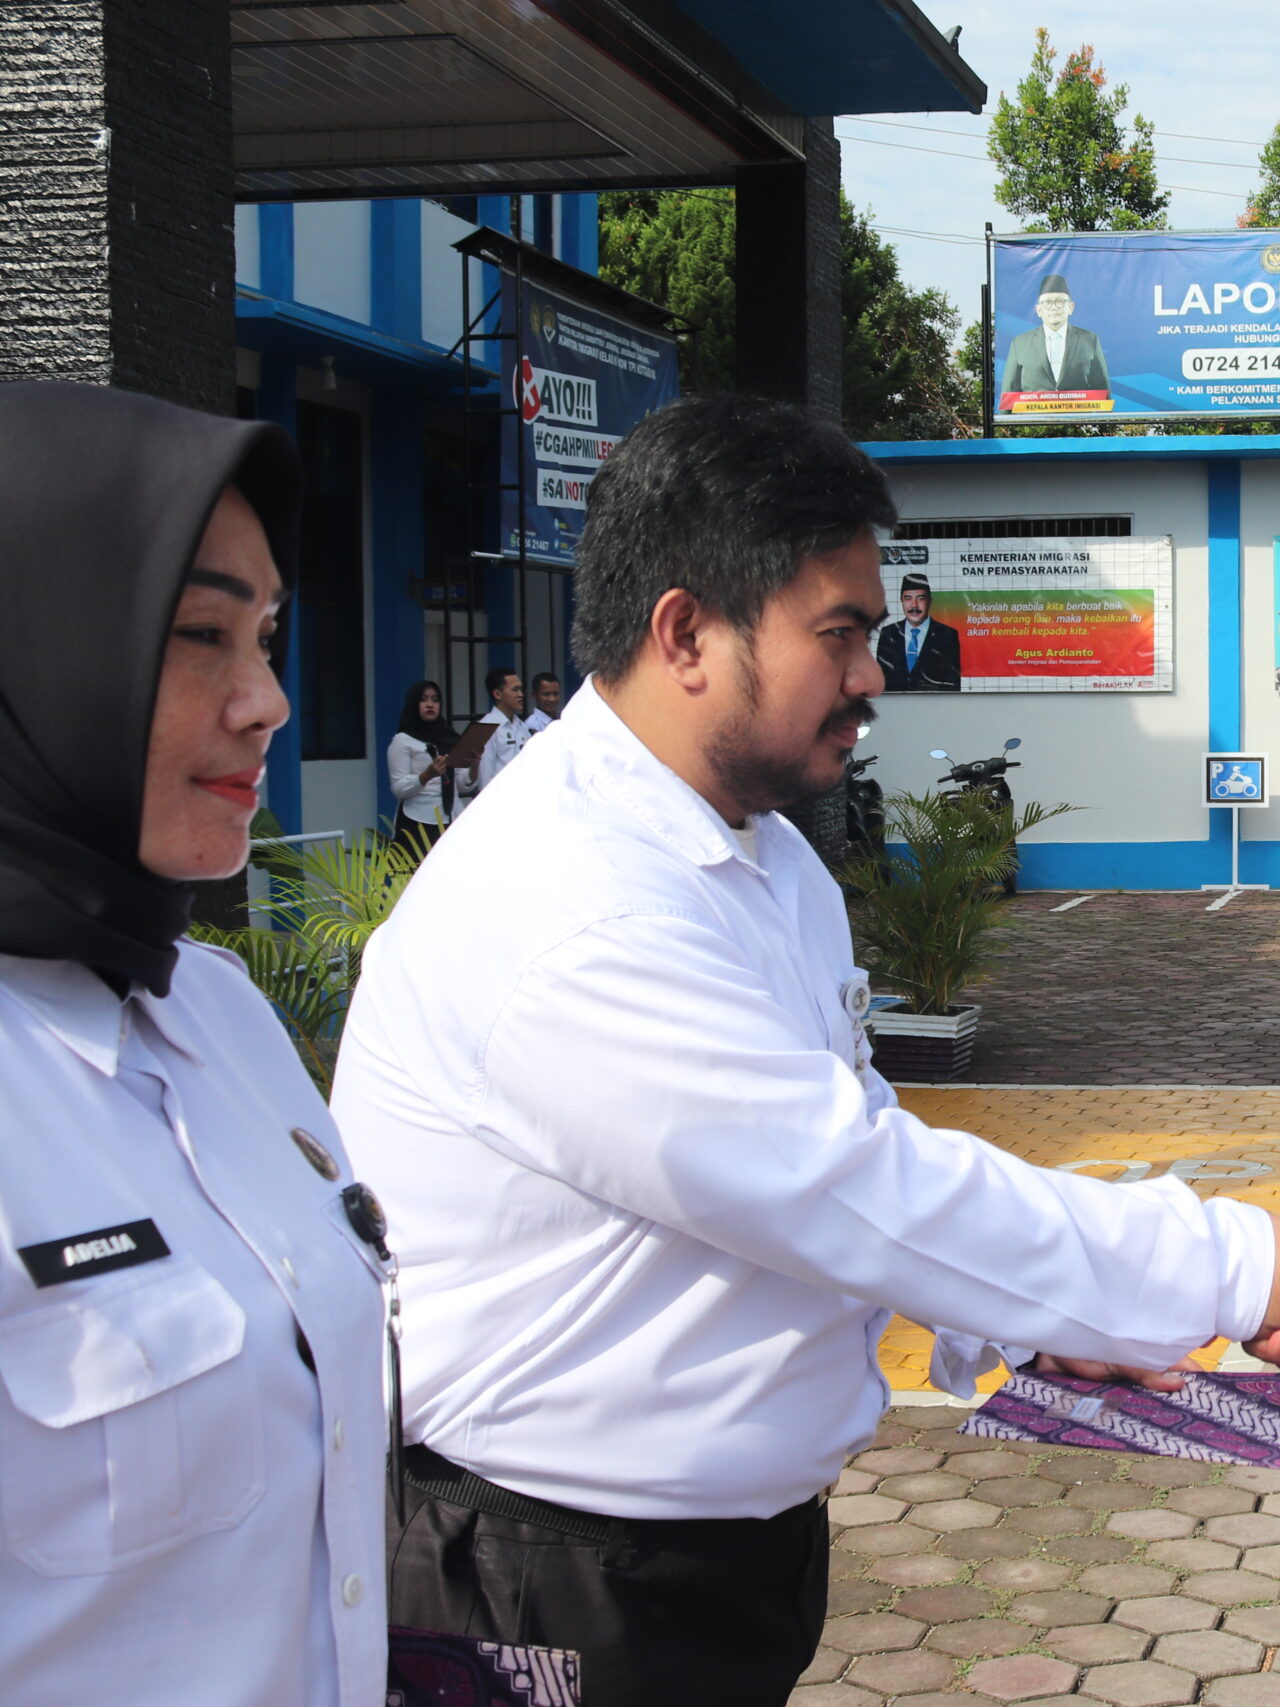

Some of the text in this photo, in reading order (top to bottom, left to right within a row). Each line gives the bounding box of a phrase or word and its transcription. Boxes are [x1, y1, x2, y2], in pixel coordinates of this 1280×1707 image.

[1157, 325, 1181, 335] JIKA
[1183, 324, 1228, 334] TERJADI
[1231, 323, 1280, 333] KENDALA
[1192, 356, 1240, 372] 0724
[1177, 386, 1204, 395] KAMI
[540, 375, 592, 420] AYO!!!
[1211, 395, 1274, 405] PELAYANAN
[1026, 403, 1048, 411] KEPALA
[1050, 402, 1073, 410] KANTOR
[960, 552, 1090, 563] KEMENTERIAN IMIGRASI
[962, 565, 1088, 576] DAN PEMASYARAKATAN
[1011, 602, 1044, 613] apabila
[1046, 601, 1064, 611] kita
[1066, 602, 1101, 611] berbuat
[1103, 601, 1123, 611] baik
[967, 614, 1000, 625] kepada
[1002, 615, 1031, 625] orang
[1056, 614, 1081, 623] maka
[1084, 614, 1128, 623] kebaikan
[1130, 613, 1142, 623] itu
[967, 627, 990, 637] akan
[992, 626, 1029, 636] kembali
[1032, 626, 1067, 637] kepada
[1015, 648, 1094, 659] Agus Ardianto
[1211, 762, 1224, 779] P
[63, 1232, 137, 1268] ADELIA
